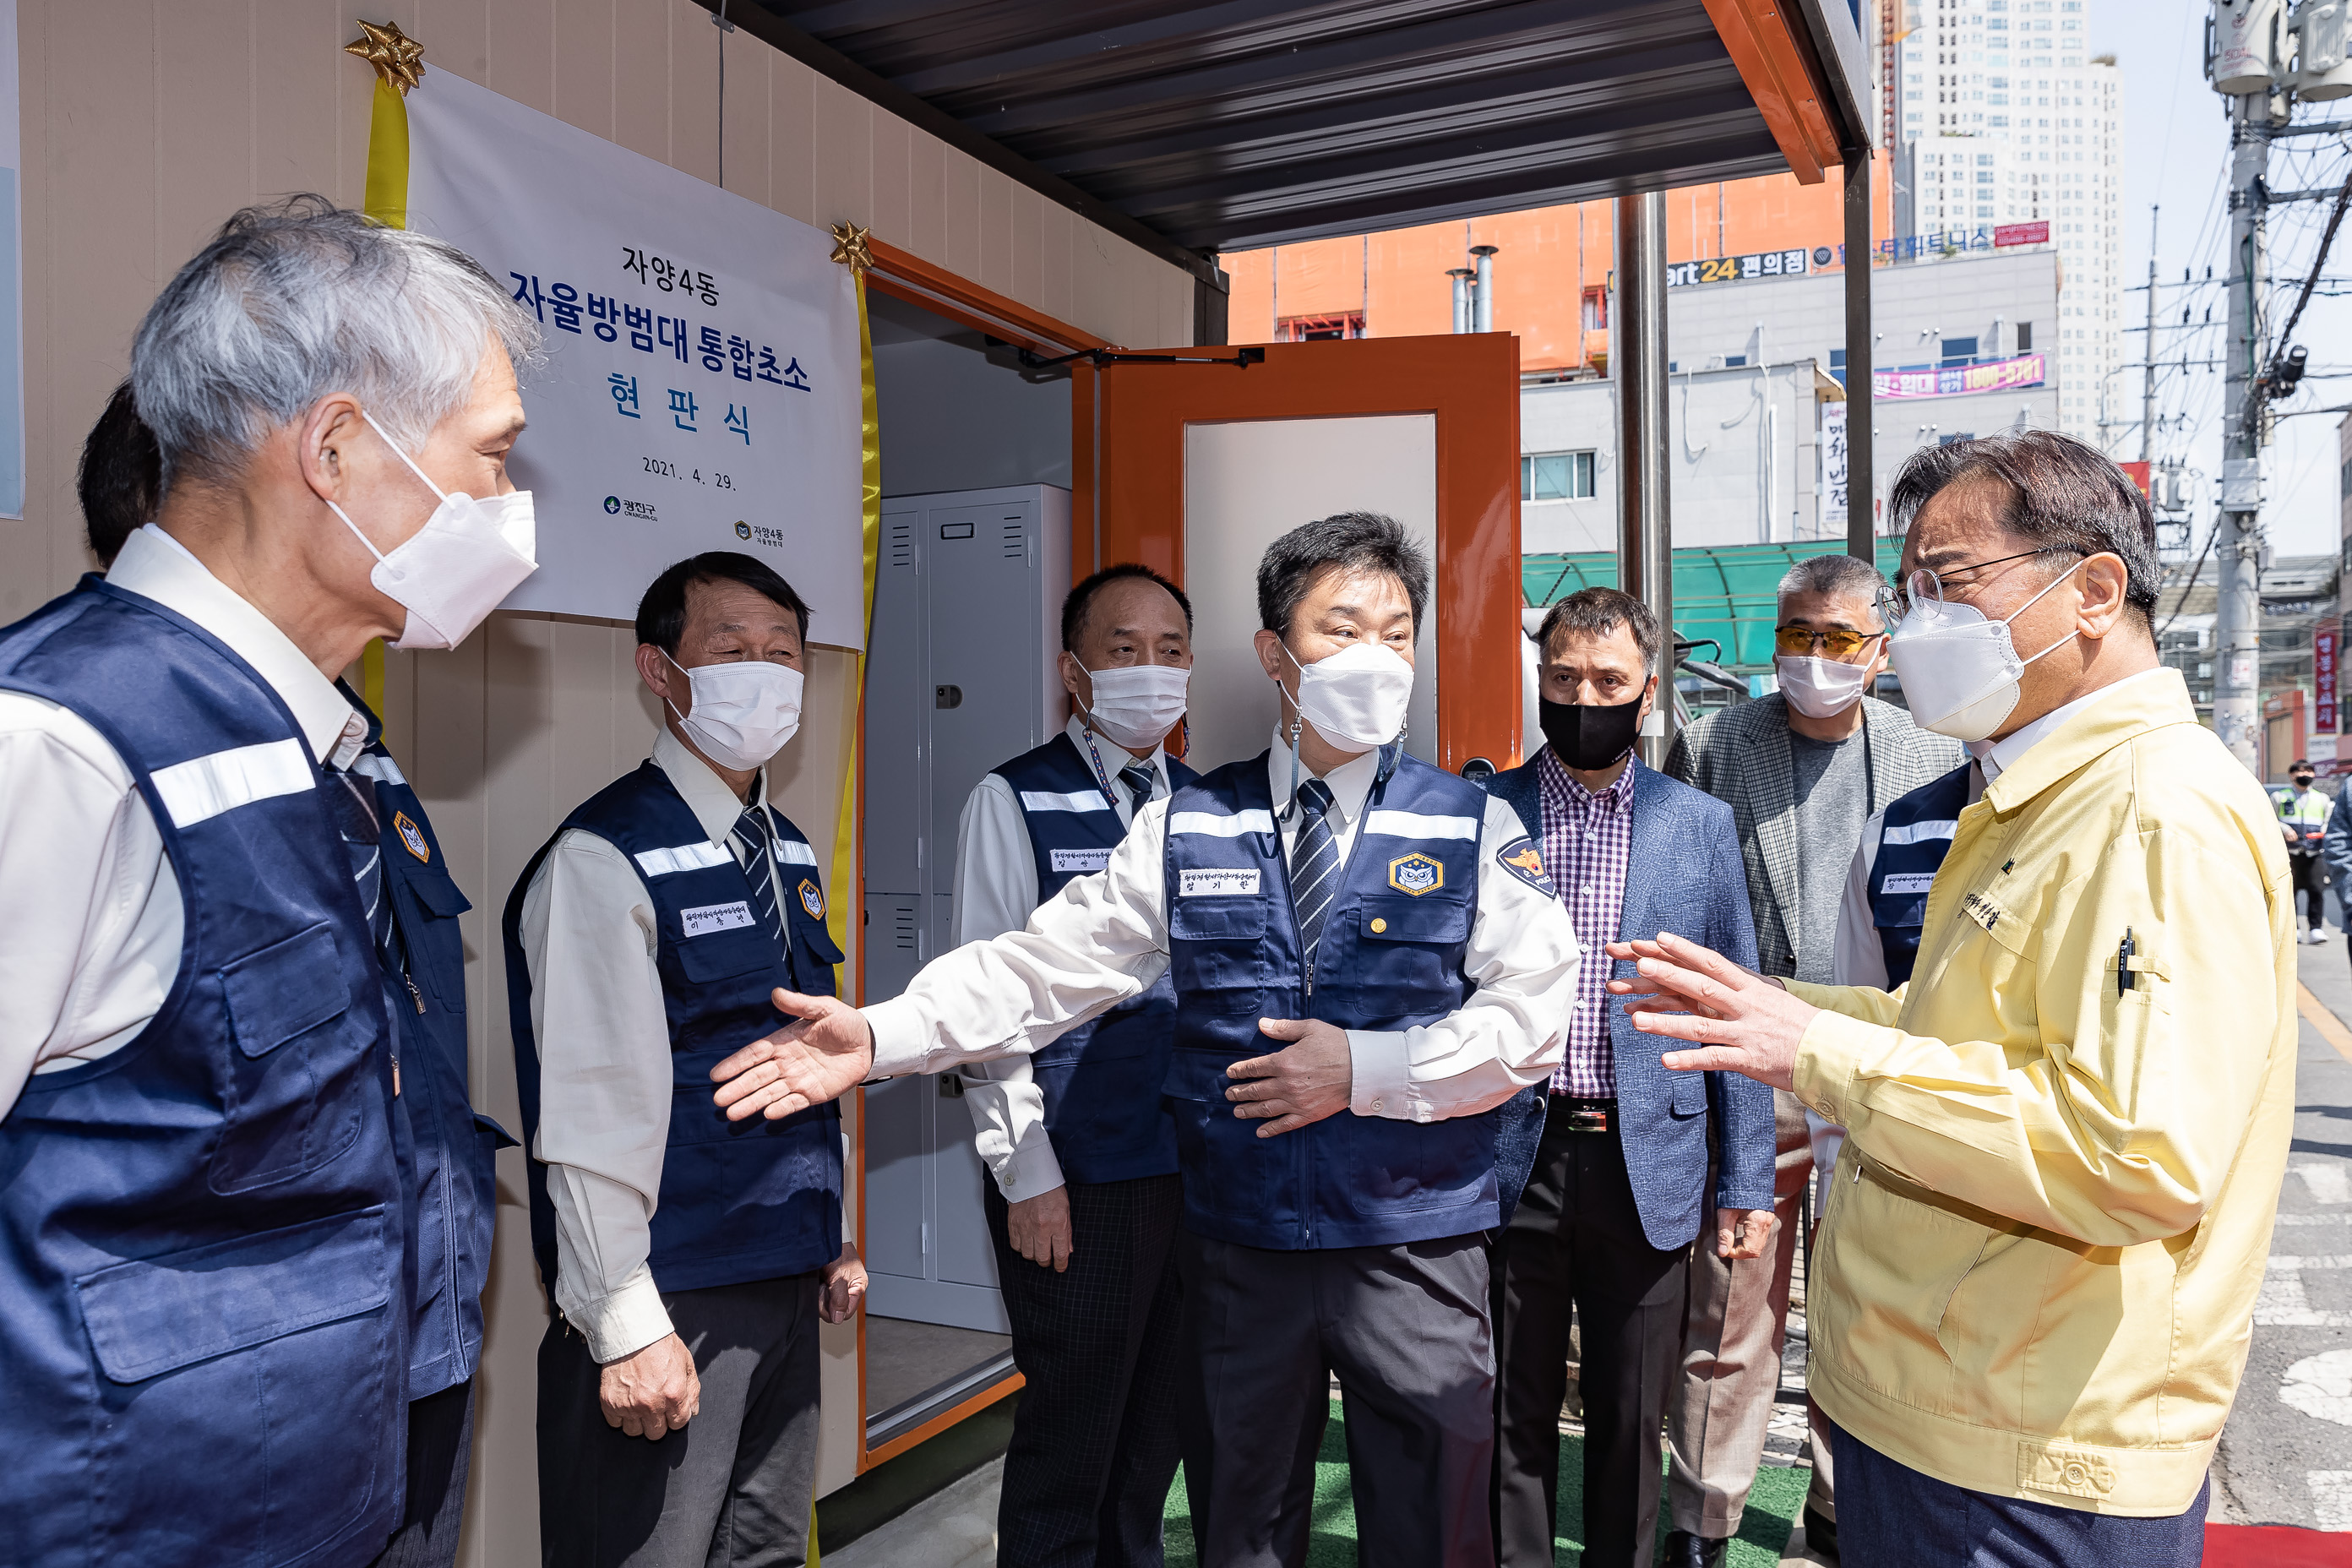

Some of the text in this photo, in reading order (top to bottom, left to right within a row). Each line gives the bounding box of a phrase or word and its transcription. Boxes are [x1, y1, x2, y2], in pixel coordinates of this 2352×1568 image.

[1741, 250, 1805, 280] 편의점
[622, 246, 721, 307] 자양4동
[509, 270, 812, 392] 자율방범대 통합초소
[607, 372, 751, 446] 현 판 식
[642, 456, 738, 492] 2021. 4. 29.
[623, 498, 656, 515] 광진구
[623, 510, 659, 522] GWANGJIN-GU
[753, 525, 784, 541] 자양4동
[756, 537, 783, 548] 자율방범대
[1212, 880, 1221, 890] 기
[1394, 883, 1438, 894] CITIZEN PATROL
[1534, 875, 1552, 886] POLIC
[690, 921, 700, 930] 이
